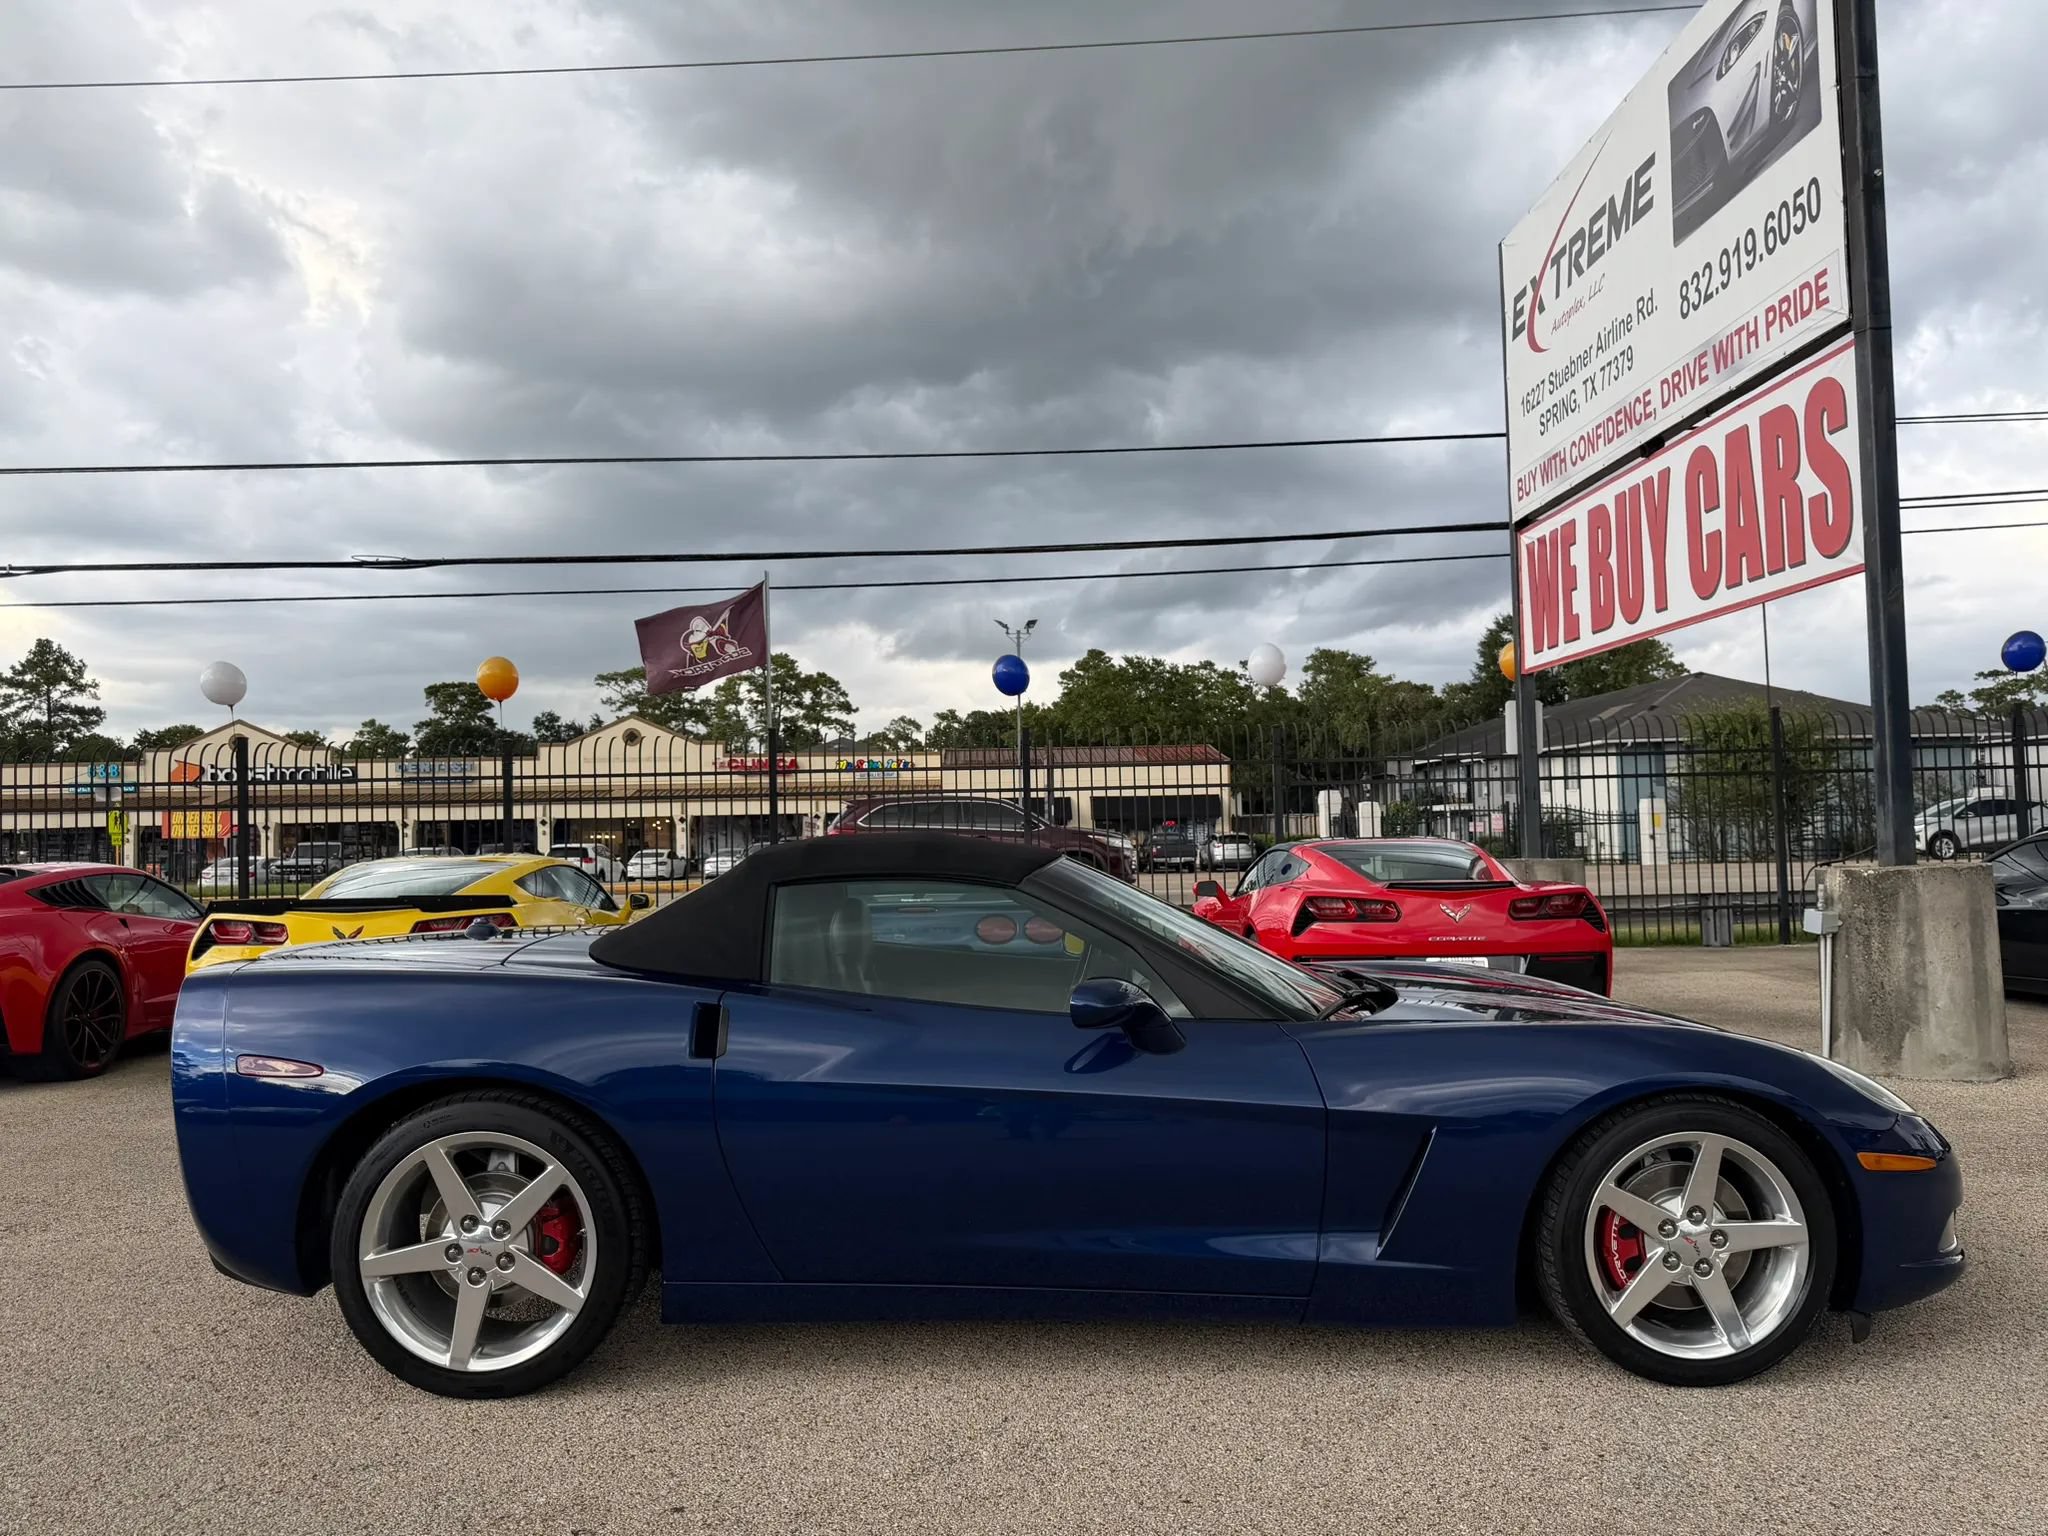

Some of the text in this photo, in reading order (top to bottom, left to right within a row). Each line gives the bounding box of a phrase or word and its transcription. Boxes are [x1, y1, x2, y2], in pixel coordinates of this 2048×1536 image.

[1512, 152, 1656, 342] EXTREME
[1588, 272, 1606, 301] LLC
[1680, 177, 1821, 319] 832.919.6050
[1517, 267, 1831, 502] BUY WITH CONFIDENCE, DRIVE WITH PRIDE
[1521, 287, 1658, 417] 16227 Stuebner Airline Rd.
[1539, 344, 1634, 437] SPRING, TX 77379
[1526, 376, 1854, 655] WE BUY CARS
[727, 758, 799, 769] CLINCA
